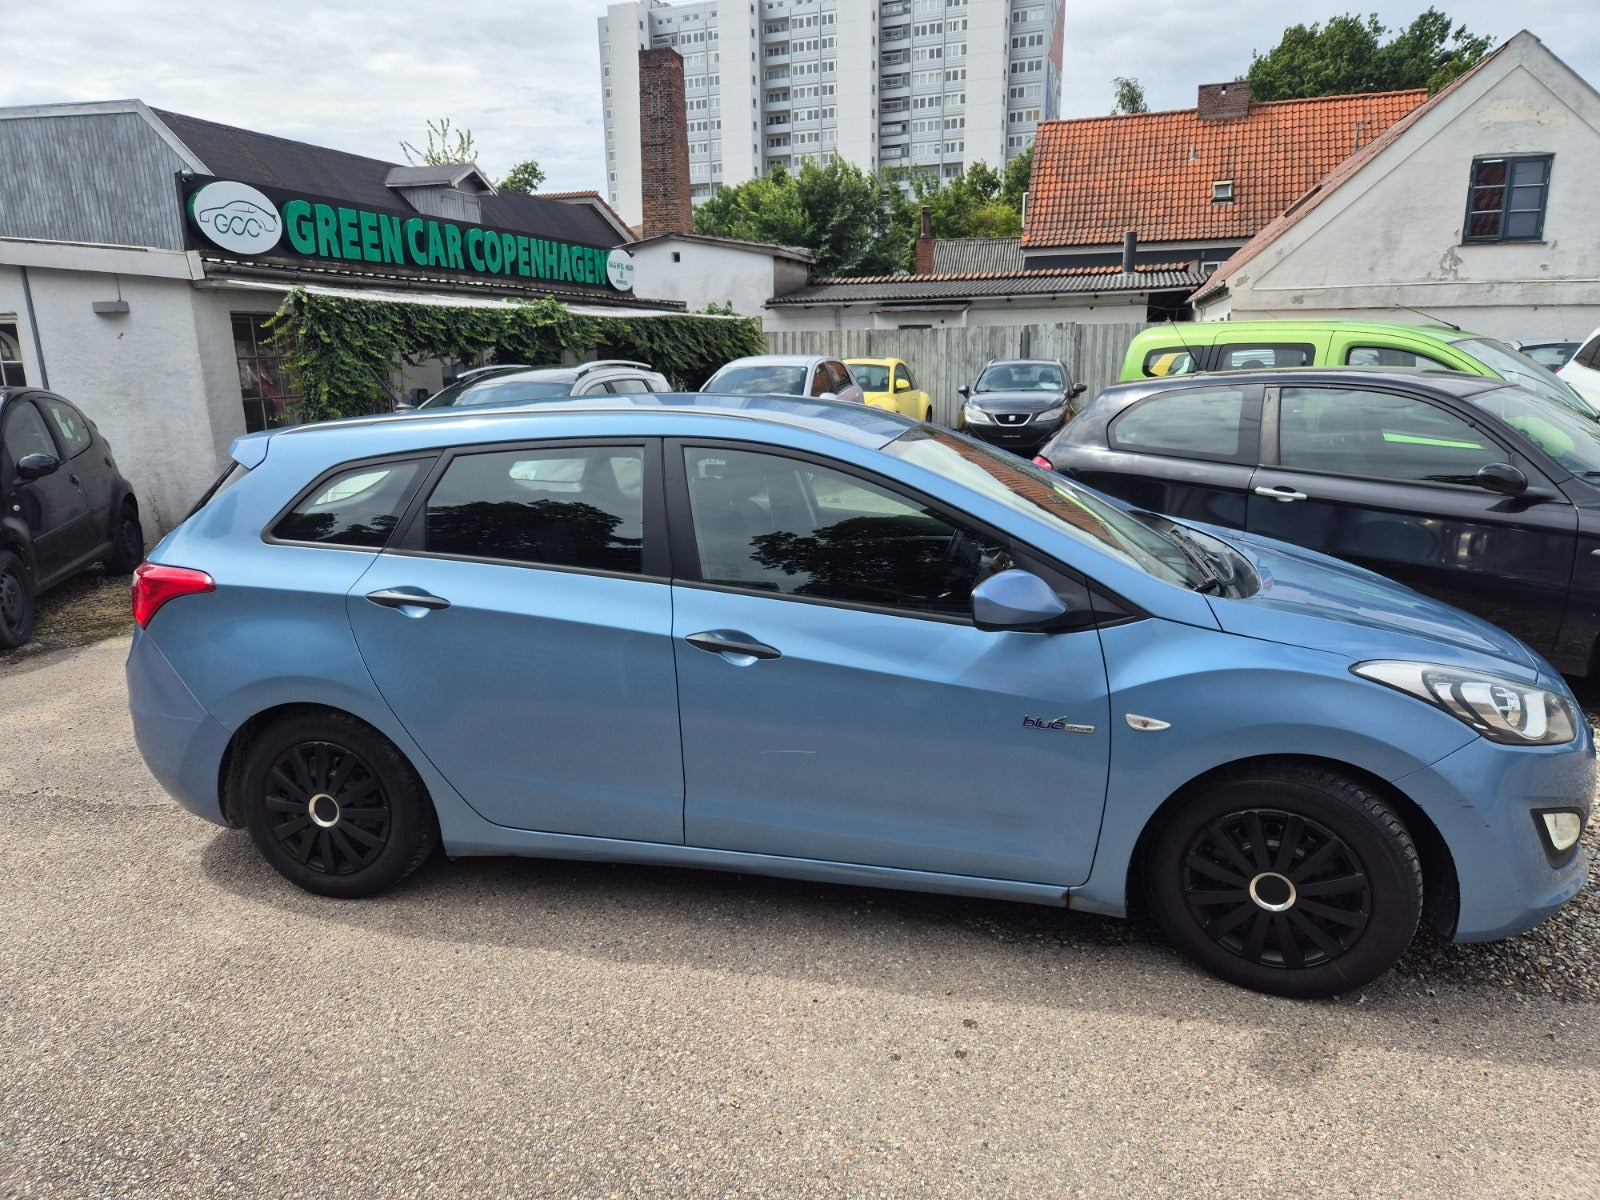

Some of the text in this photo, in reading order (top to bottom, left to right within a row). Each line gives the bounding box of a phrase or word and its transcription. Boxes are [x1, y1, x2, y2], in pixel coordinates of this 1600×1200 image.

[285, 199, 606, 285] GREEN CAR COPENHAGEN
